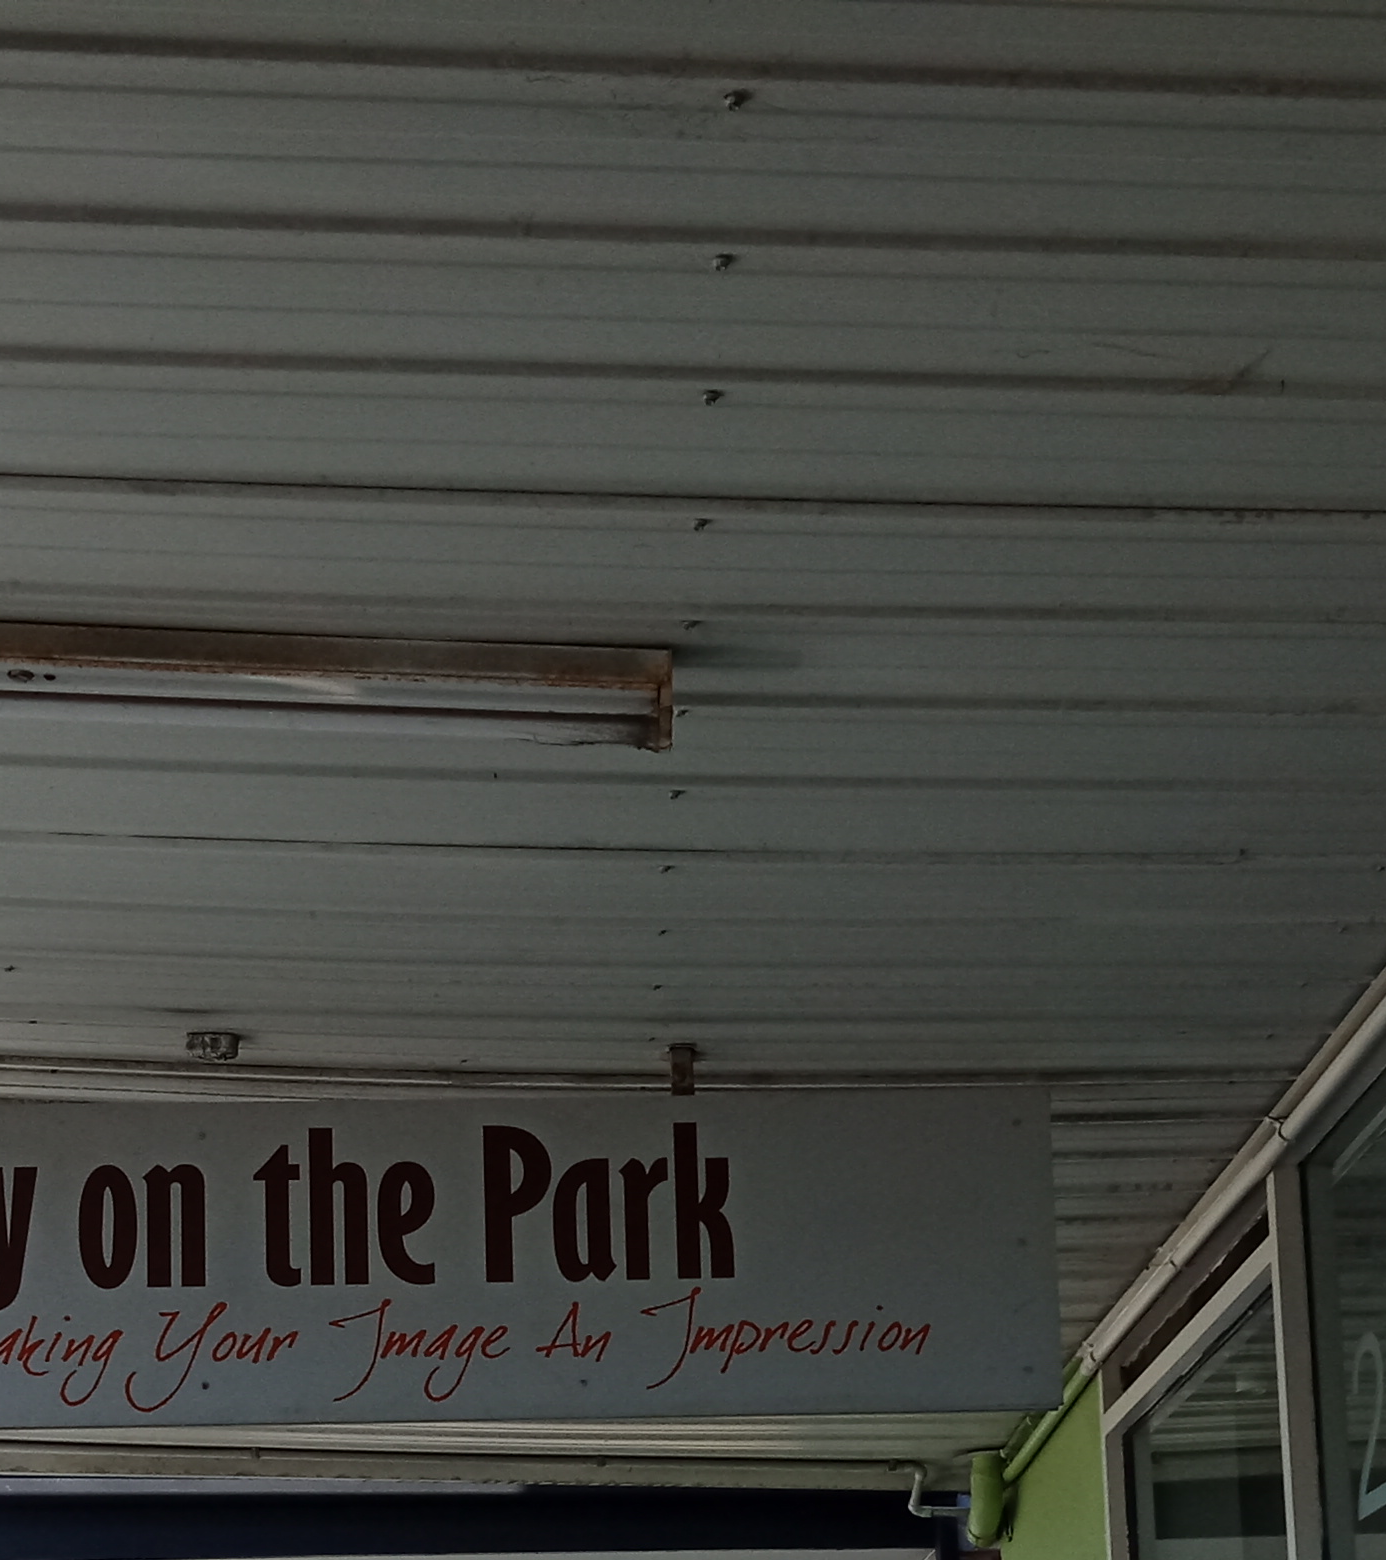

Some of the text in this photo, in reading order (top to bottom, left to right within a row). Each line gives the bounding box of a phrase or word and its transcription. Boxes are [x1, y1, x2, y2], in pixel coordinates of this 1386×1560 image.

[78, 1160, 207, 1289] on
[253, 1127, 436, 1287] the
[482, 1122, 735, 1287] Park
[125, 1301, 300, 1413] Your
[331, 1297, 512, 1403] Image
[537, 1314, 613, 1365] An
[641, 1286, 933, 1391] Impression
